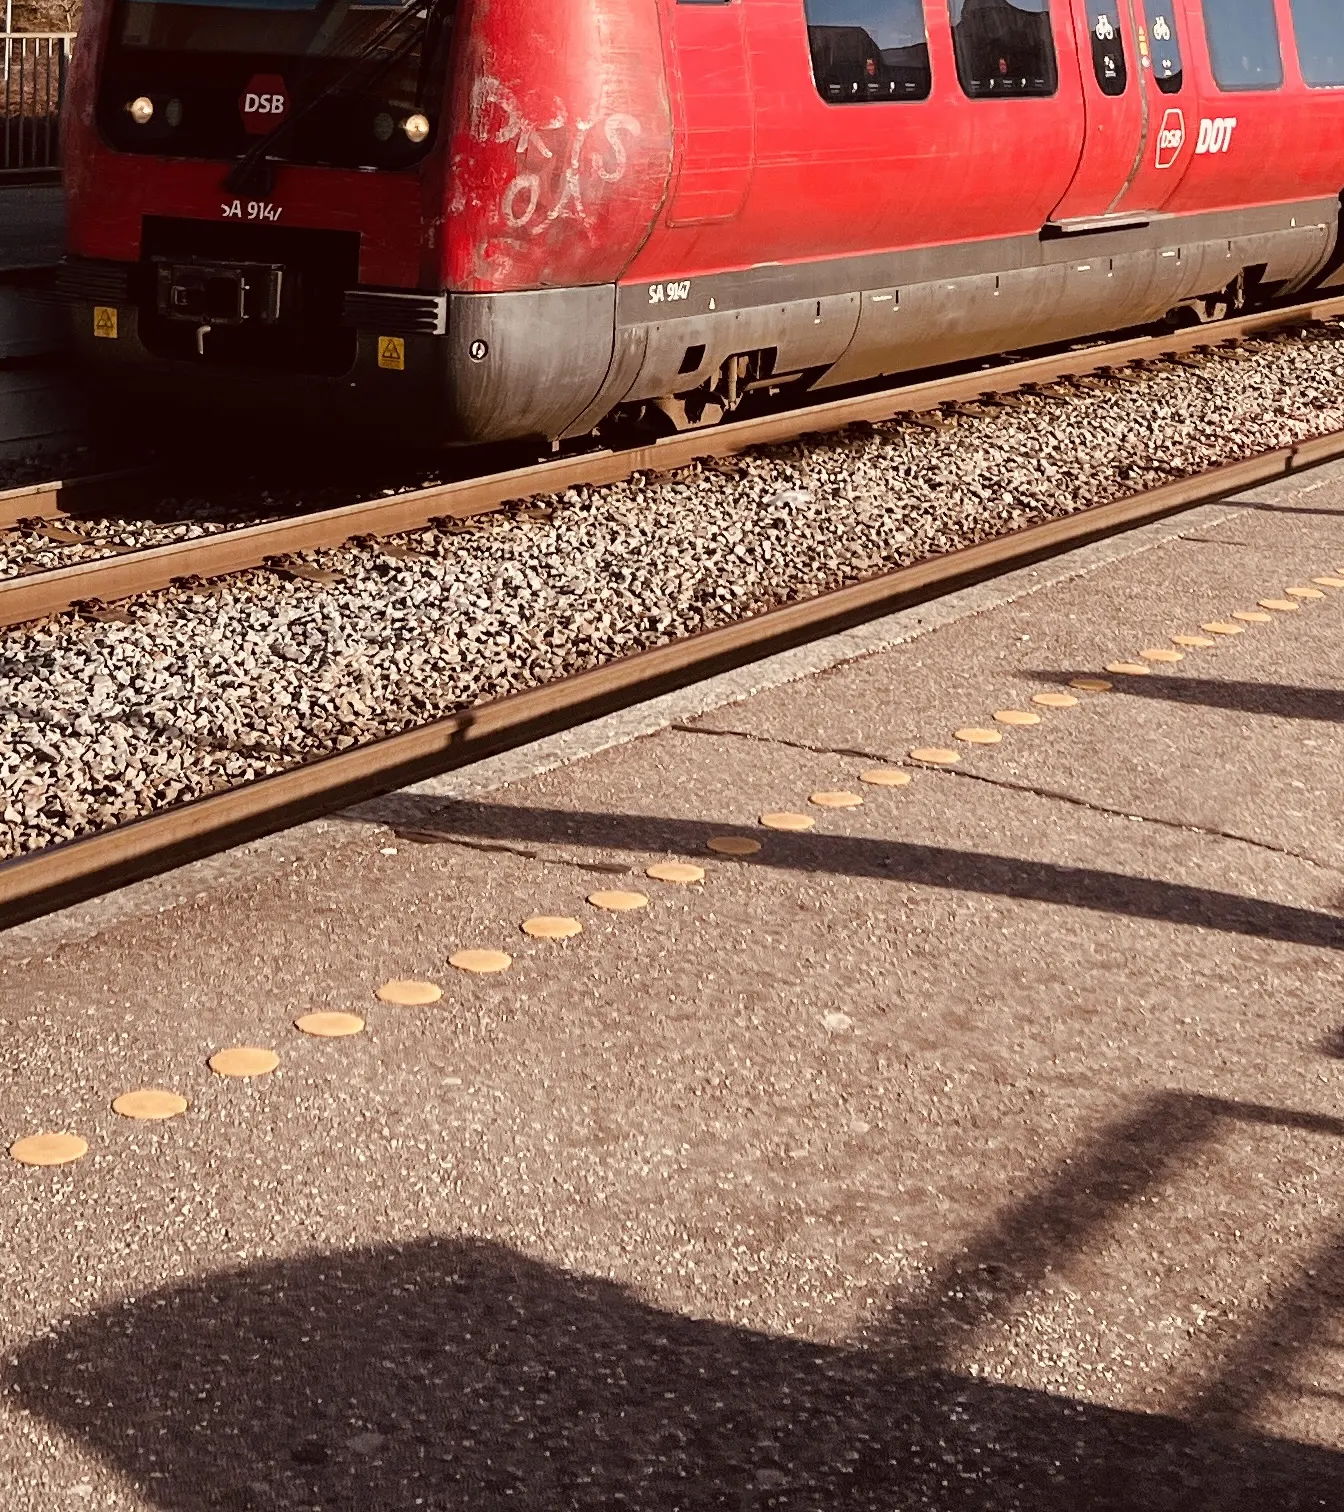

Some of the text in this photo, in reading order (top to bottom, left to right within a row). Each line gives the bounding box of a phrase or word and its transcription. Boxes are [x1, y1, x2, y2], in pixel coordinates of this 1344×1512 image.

[244, 93, 284, 114] DSB
[1160, 129, 1182, 149] DSB
[1195, 117, 1237, 154] DOT
[648, 280, 691, 304] SA 9147
